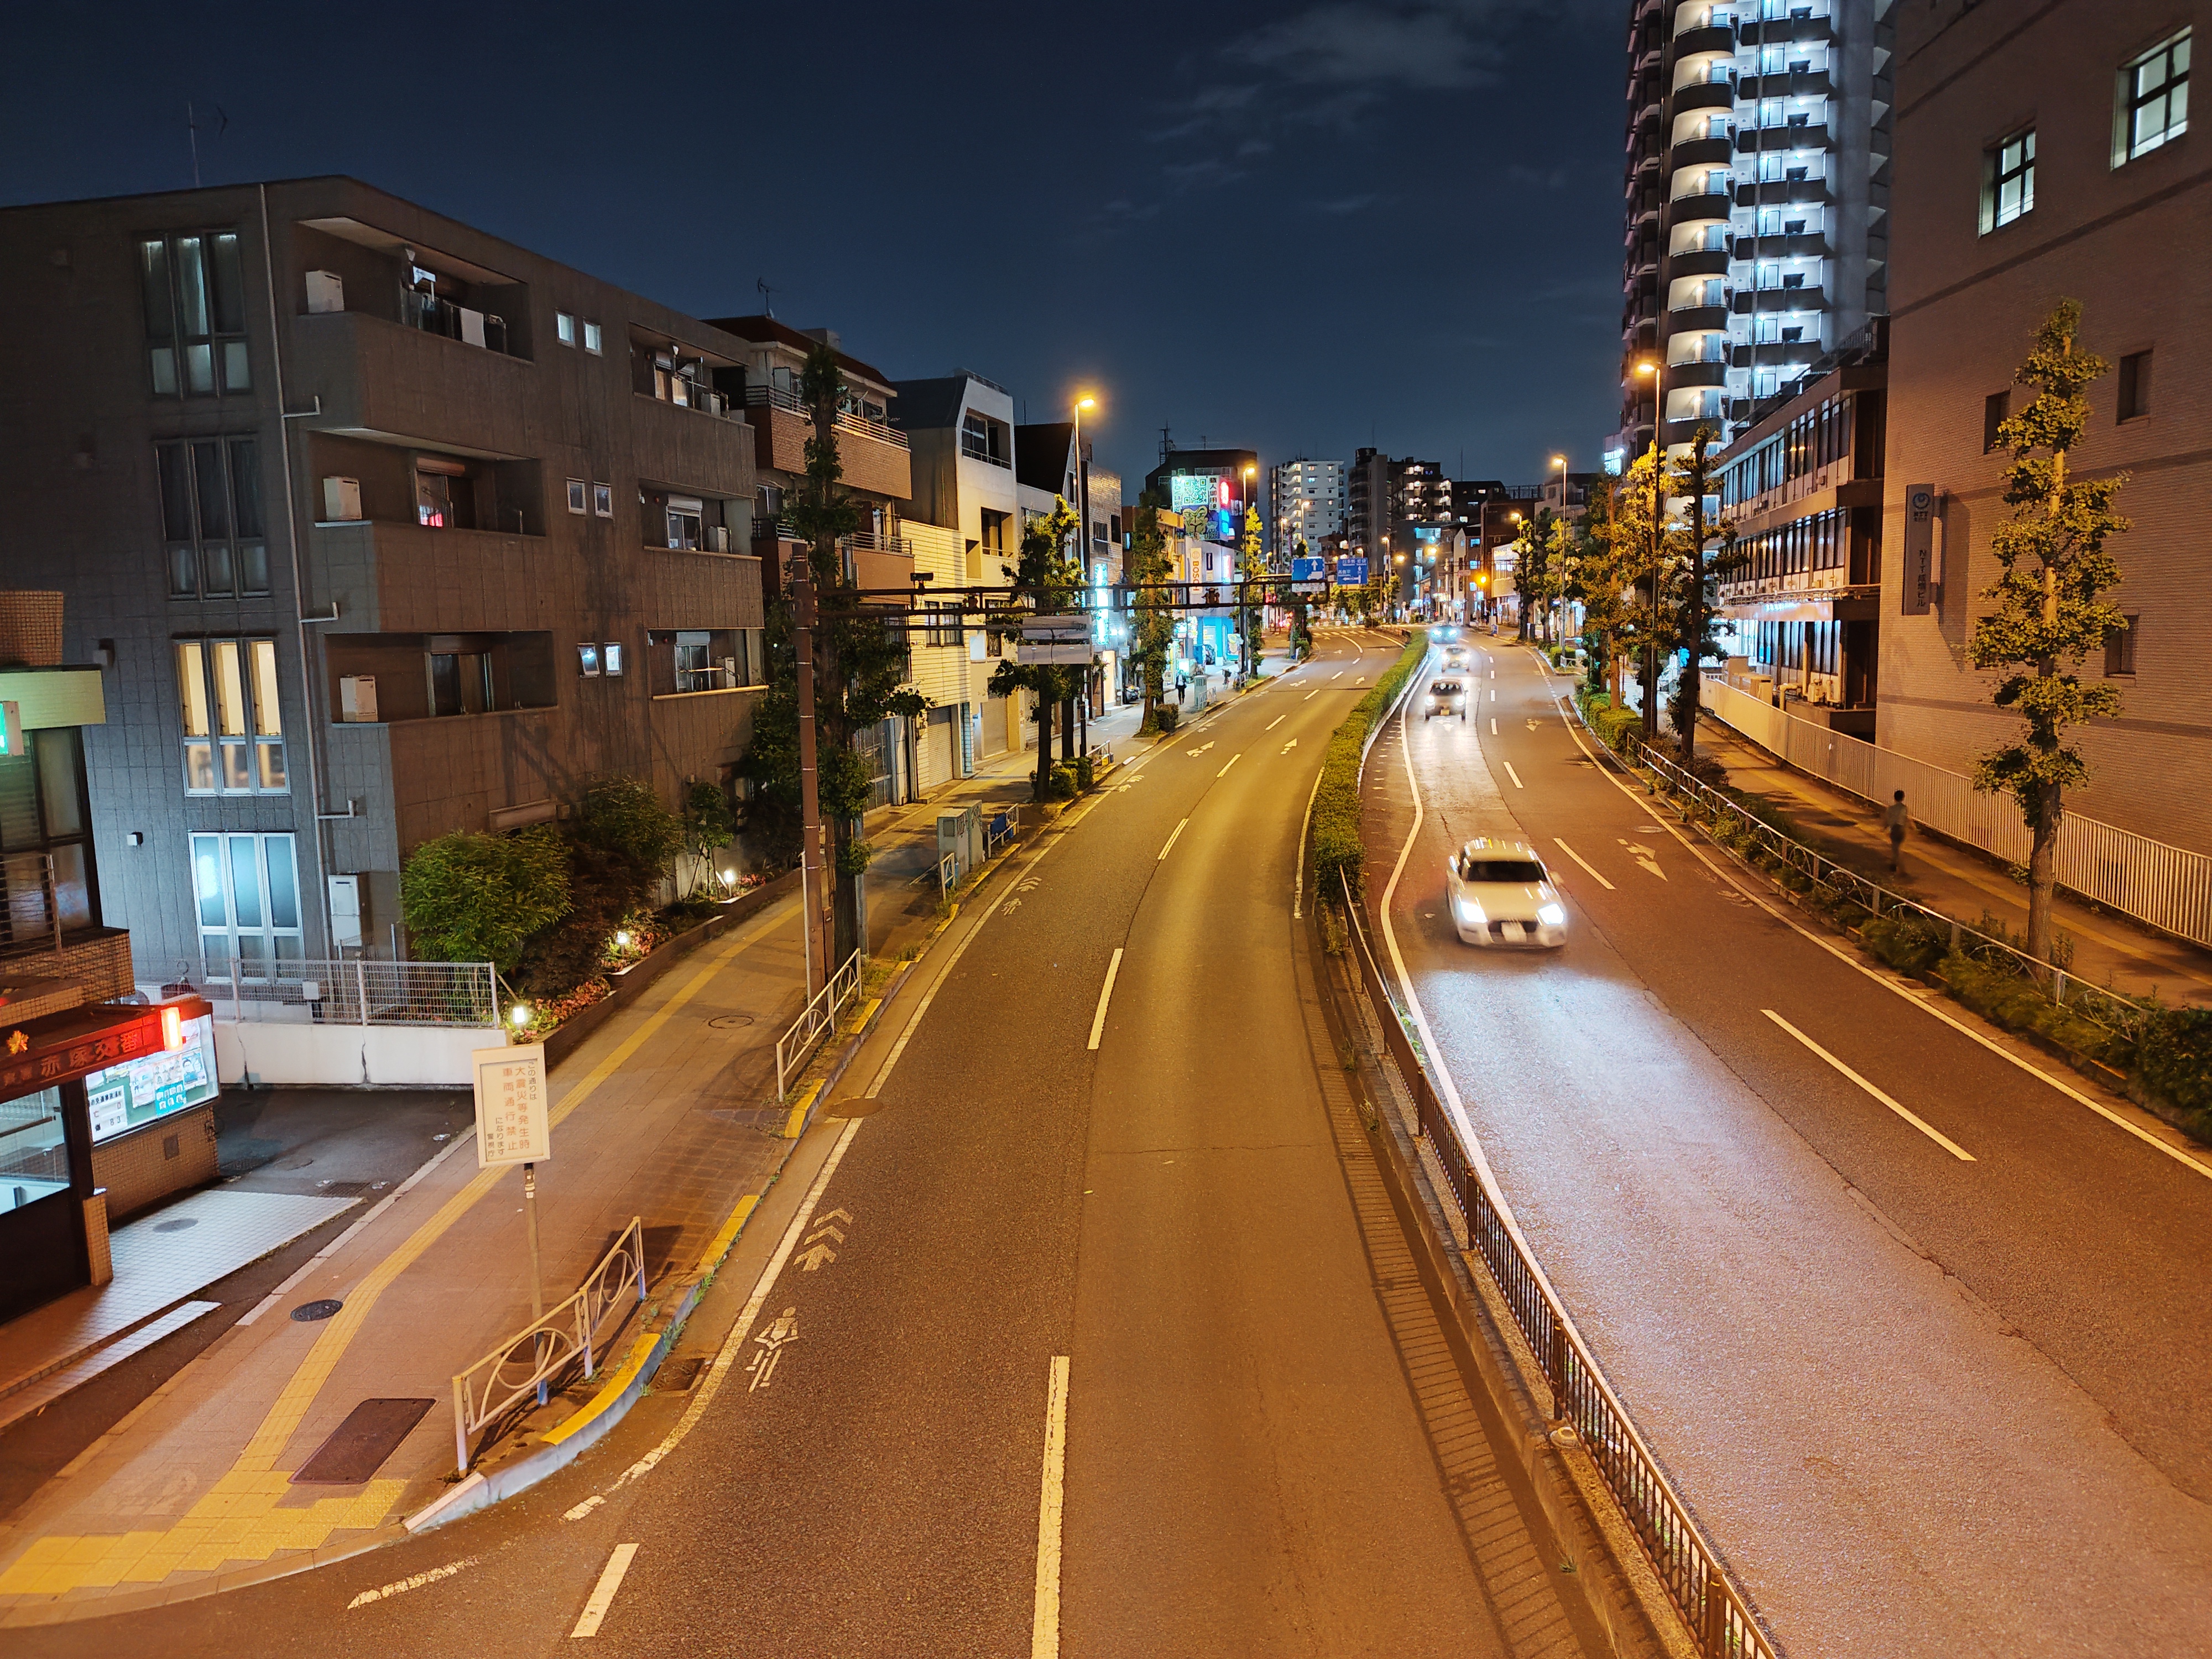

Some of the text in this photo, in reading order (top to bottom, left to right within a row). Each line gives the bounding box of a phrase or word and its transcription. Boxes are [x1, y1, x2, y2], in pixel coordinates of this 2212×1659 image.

[40, 1030, 139, 1078] 赤塚交番
[527, 1061, 537, 1100] この通りは
[502, 1067, 518, 1151] 車両通行禁止
[515, 1067, 530, 1150] 大震災等発生時
[487, 1133, 495, 1157] 警視庁
[495, 1117, 504, 1156] になります
